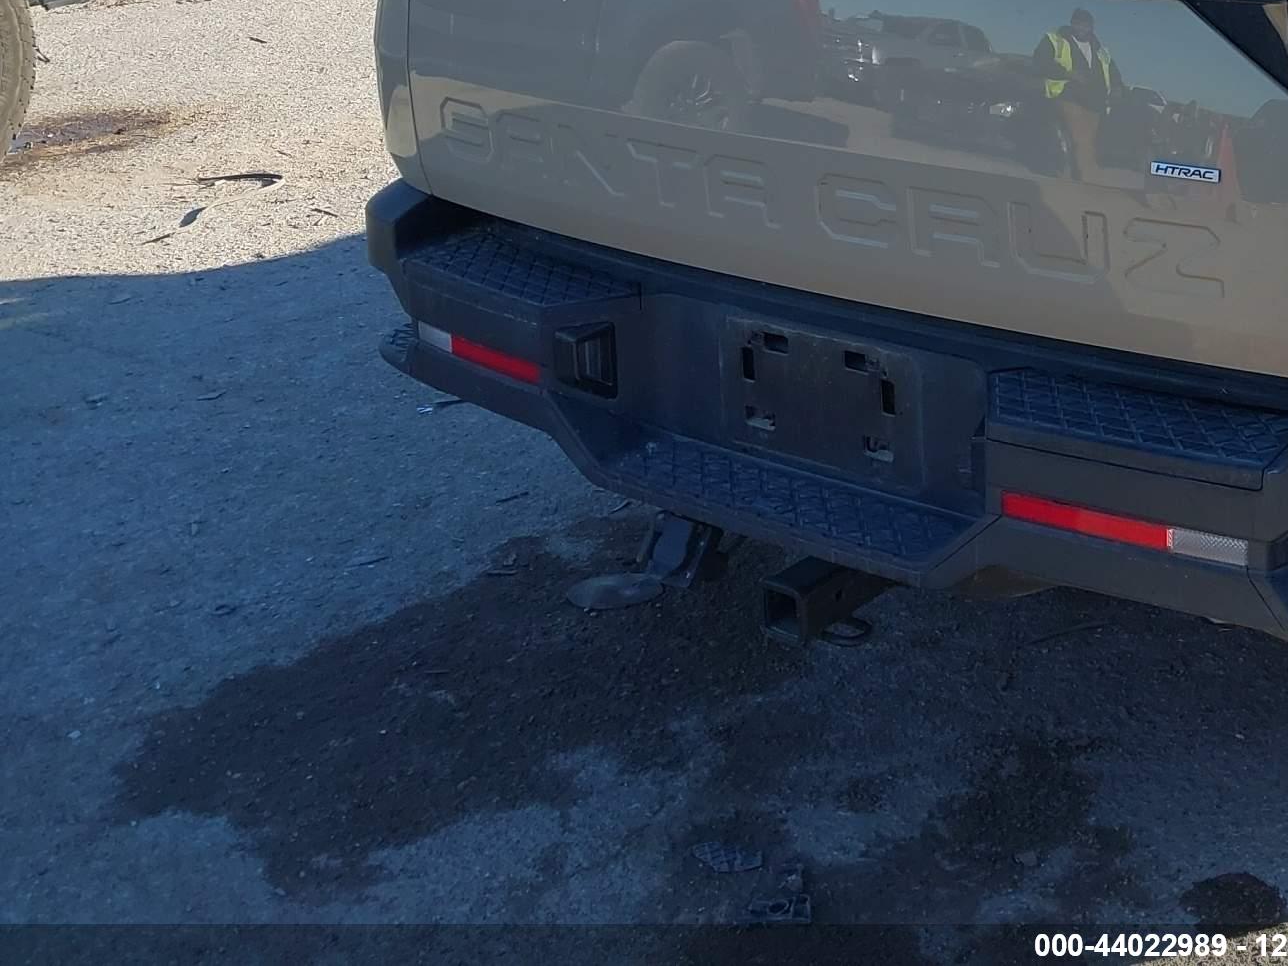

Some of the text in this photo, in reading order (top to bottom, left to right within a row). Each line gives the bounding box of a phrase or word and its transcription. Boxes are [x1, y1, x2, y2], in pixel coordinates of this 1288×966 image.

[440, 96, 1225, 298] SANTA CRUZ
[1155, 164, 1215, 180] HTRAC
